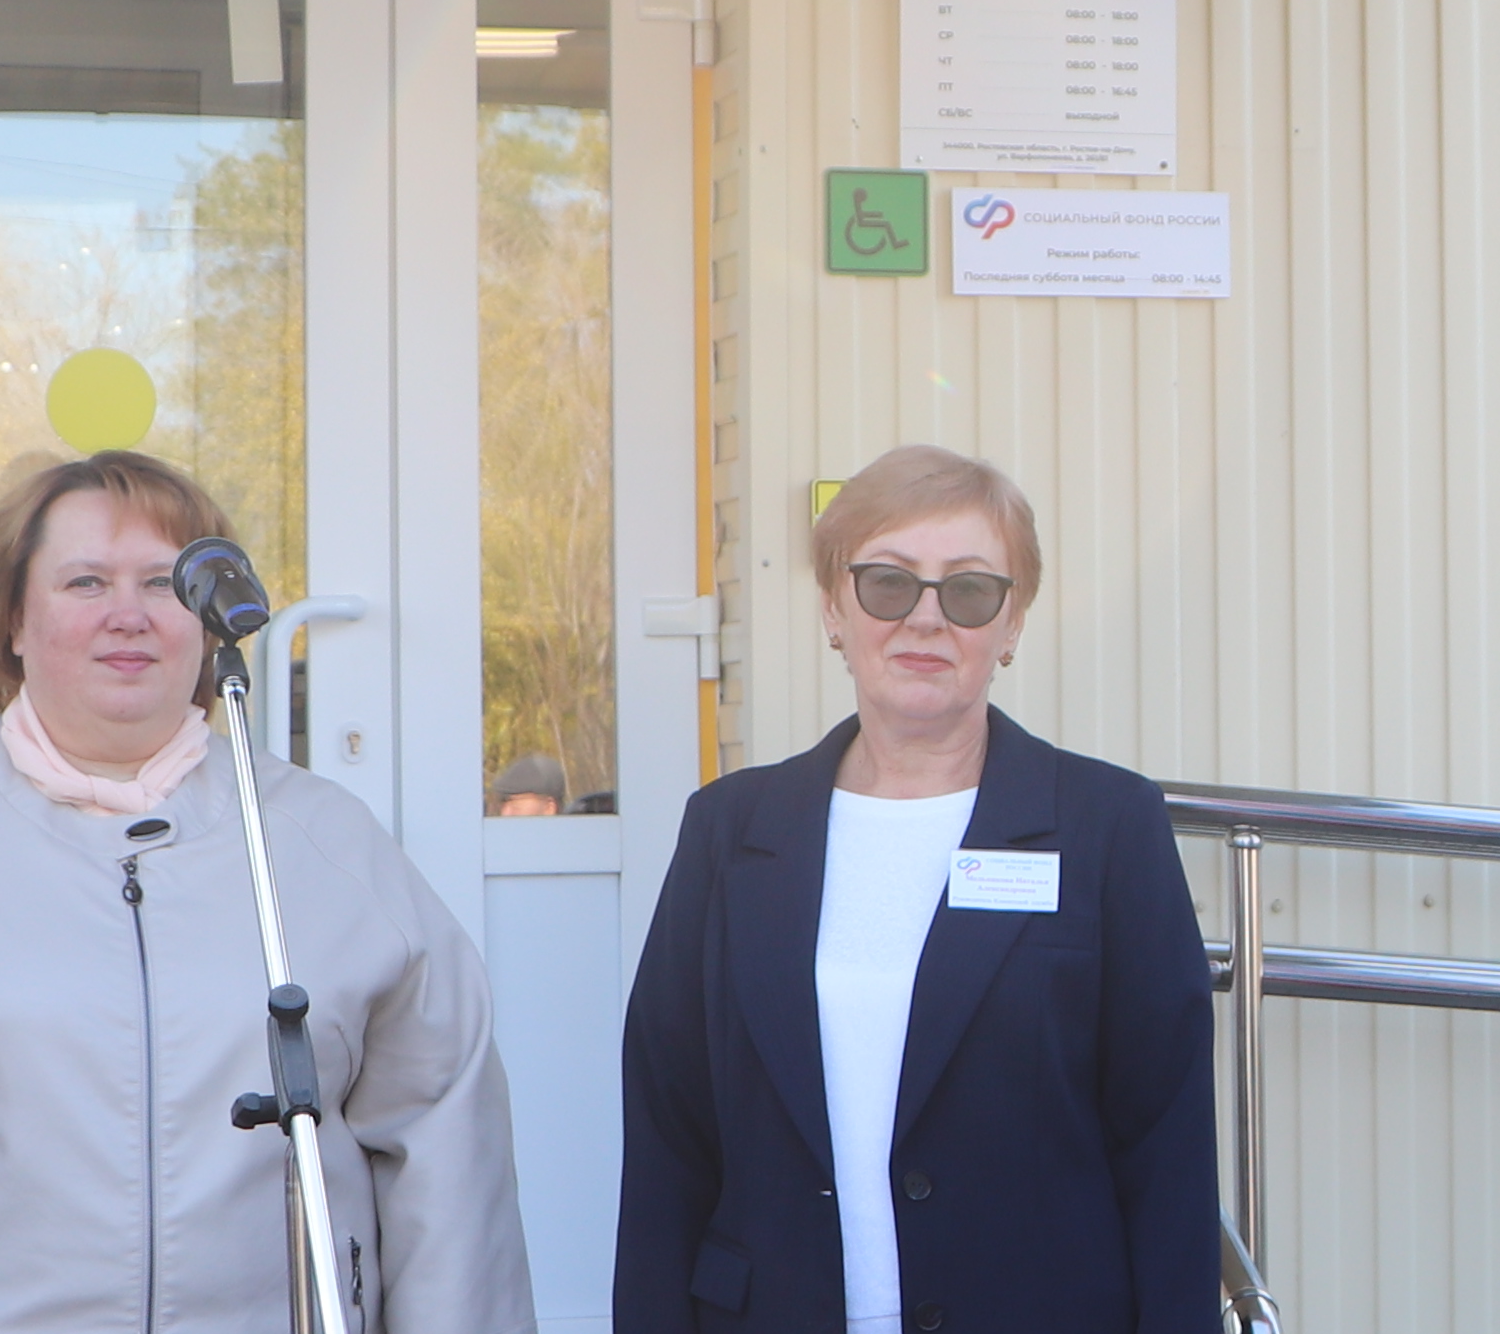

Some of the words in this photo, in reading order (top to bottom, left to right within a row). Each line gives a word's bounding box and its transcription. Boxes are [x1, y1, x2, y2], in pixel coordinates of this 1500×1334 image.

[939, 4, 952, 15] ВТ
[1065, 9, 1096, 19] 08:00
[1111, 11, 1139, 21] 18:00
[939, 30, 954, 41] СР
[1065, 34, 1096, 44] 08:00
[1111, 36, 1139, 46] 18:00
[939, 55, 952, 66] ЧТ
[1065, 60, 1096, 70] 08:00
[1111, 61, 1139, 71] 18:00
[939, 81, 953, 92] ПТ
[1065, 85, 1096, 95] 08:00
[1111, 86, 1138, 96] 16:45
[939, 107, 973, 119] СБ/ВС
[1023, 211, 1120, 226] СОЦИАЛЬНЫЙ
[1124, 213, 1164, 227] ФОНД
[1168, 215, 1221, 226] РОССИИ
[1047, 247, 1089, 259] Режим
[1093, 247, 1140, 261] работы:
[964, 271, 1029, 282] Последняя
[1032, 271, 1079, 285] суббота
[1082, 273, 1125, 283] месяца
[1152, 273, 1184, 284] 08:00
[1194, 273, 1221, 285] 14:45
